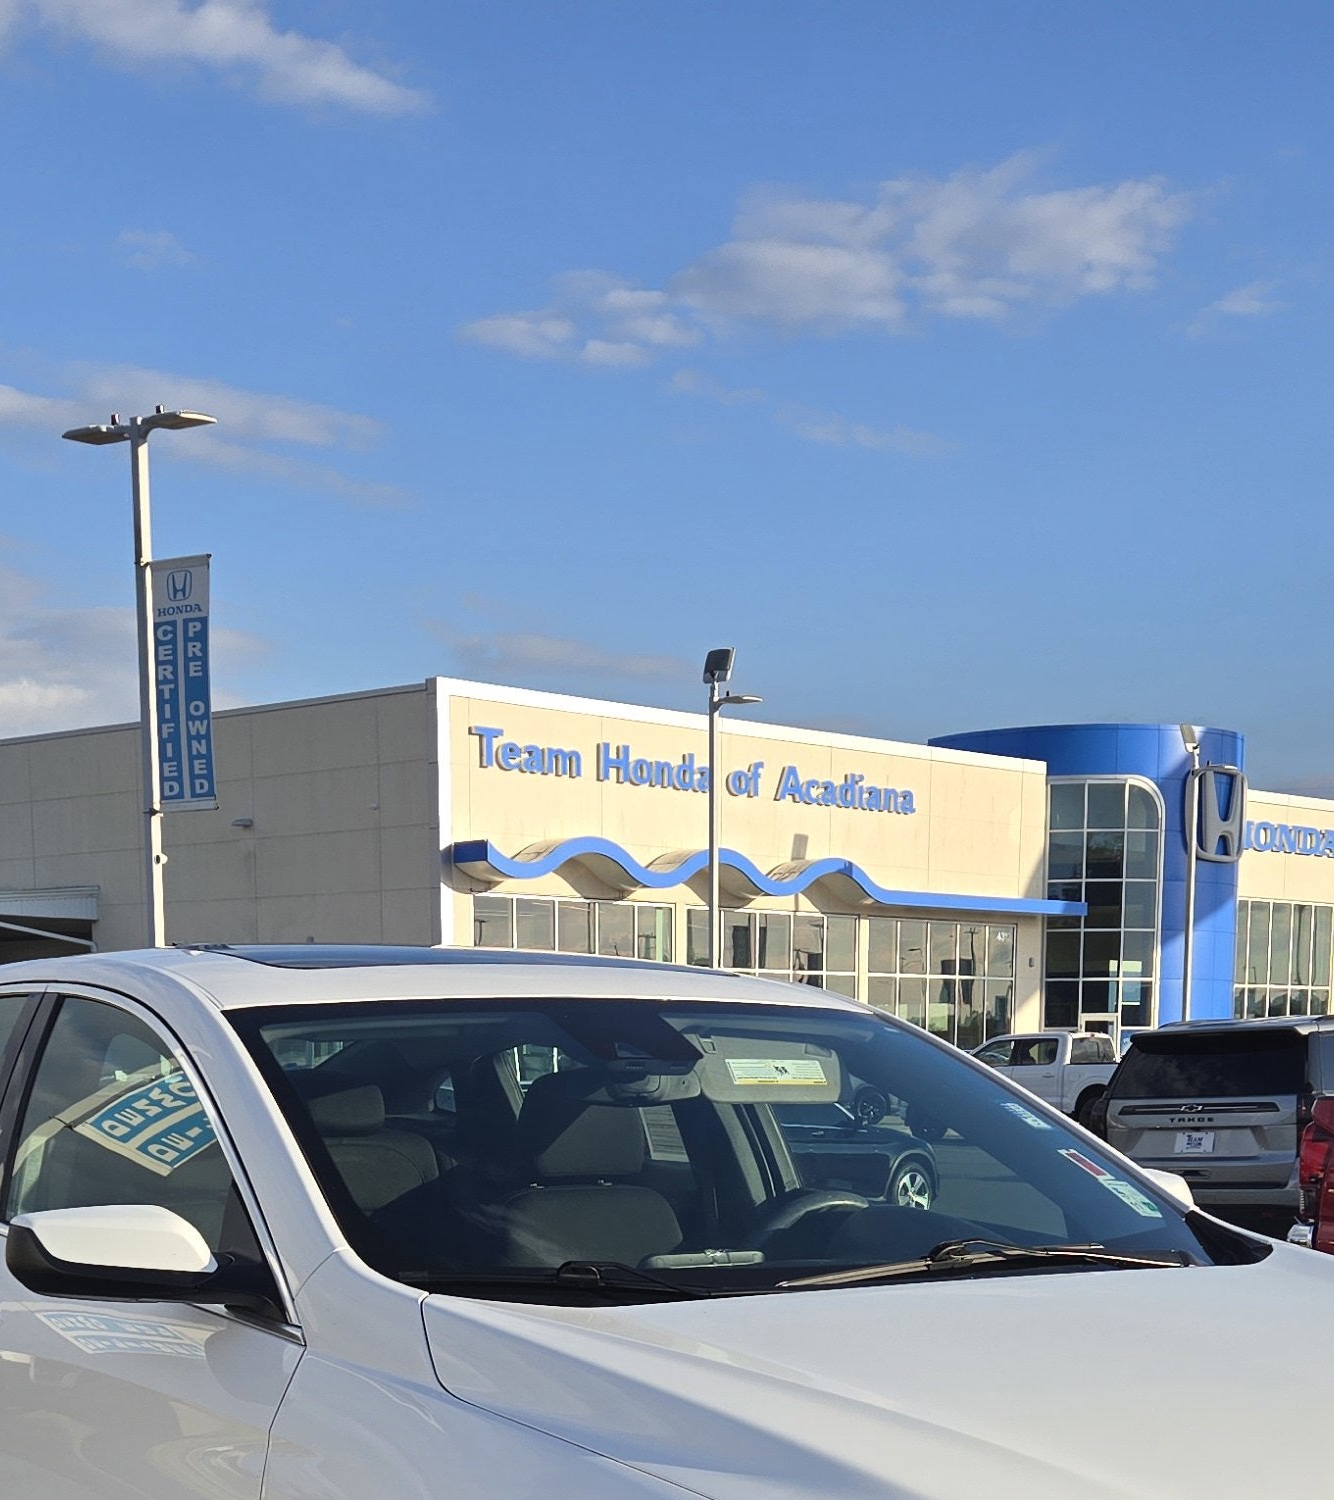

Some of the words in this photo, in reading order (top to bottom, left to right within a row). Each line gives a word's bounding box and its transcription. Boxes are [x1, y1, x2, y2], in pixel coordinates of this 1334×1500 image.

[157, 603, 203, 617] HONDA
[187, 621, 203, 678] PRE
[156, 624, 180, 797] CERTIFIED
[187, 700, 209, 794] OWNED
[468, 726, 582, 778] Team
[597, 742, 710, 793] Honda
[726, 761, 764, 798] of
[774, 765, 916, 815] Acadiana
